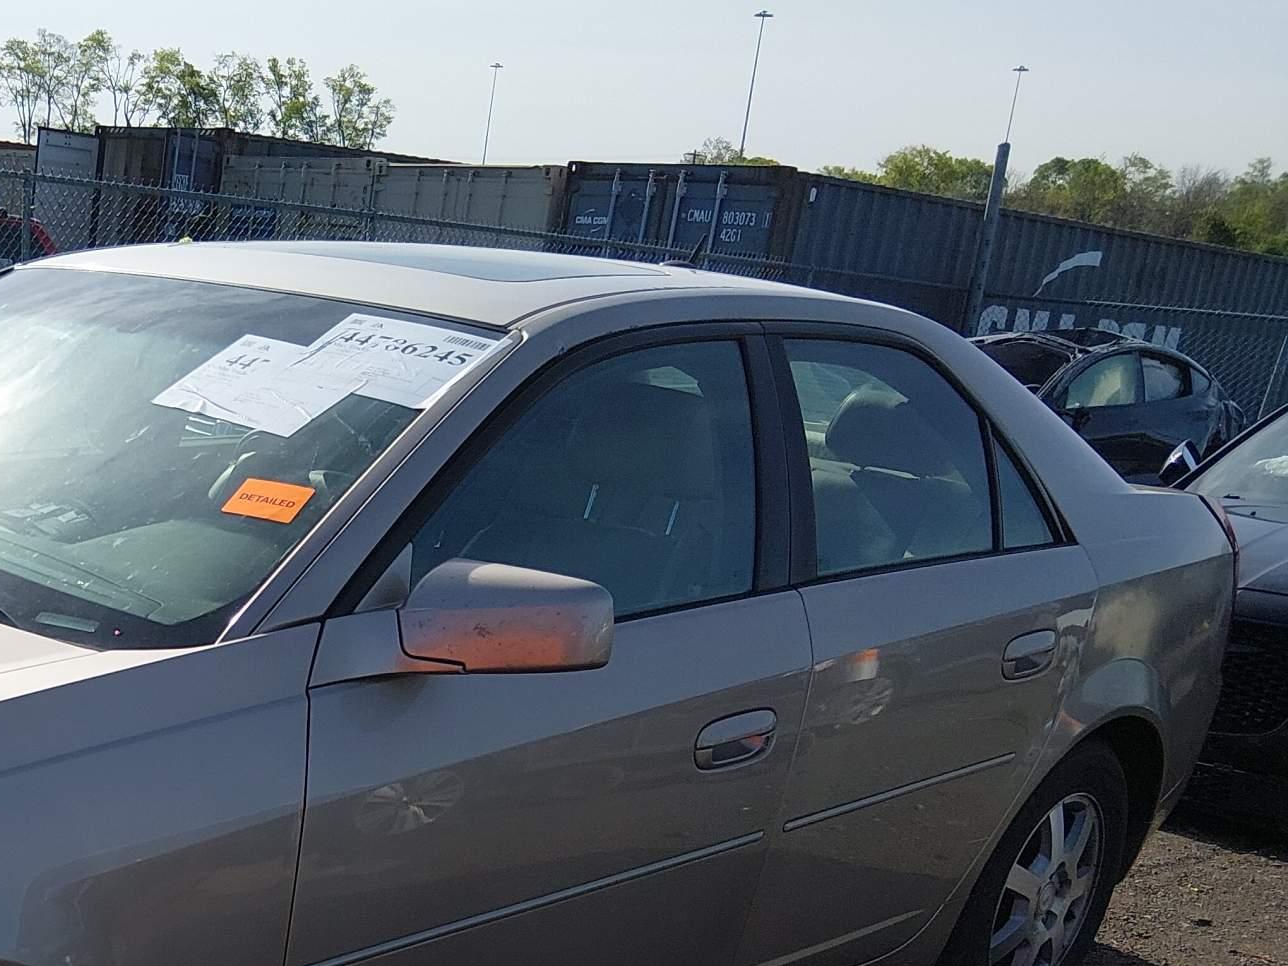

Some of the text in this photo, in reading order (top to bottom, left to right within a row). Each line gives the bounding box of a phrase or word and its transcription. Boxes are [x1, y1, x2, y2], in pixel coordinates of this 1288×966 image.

[575, 215, 592, 225] CMA
[687, 209, 712, 223] CMAU
[722, 211, 757, 226] 803073
[238, 491, 297, 510] DETAILED
